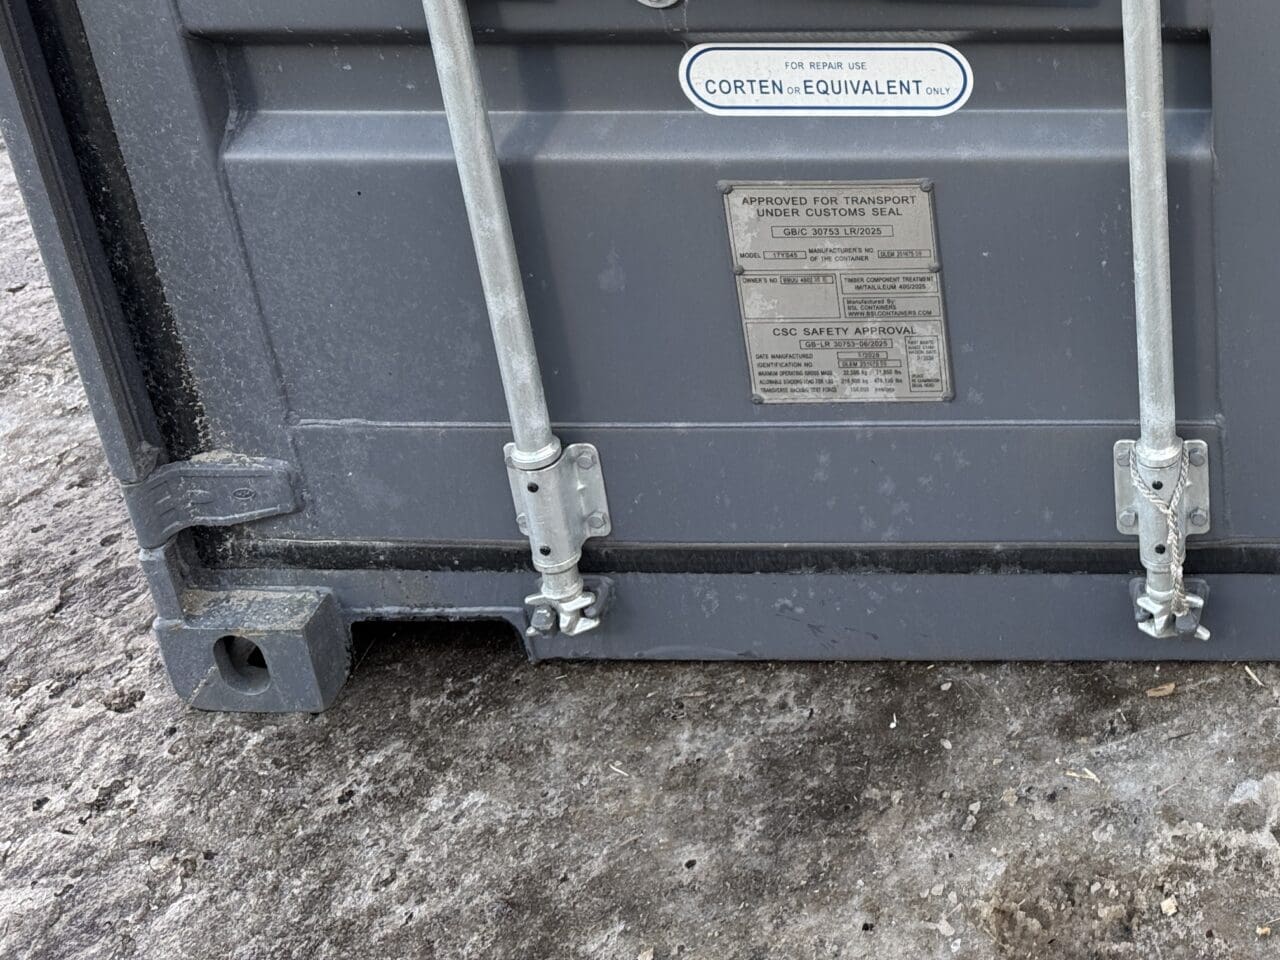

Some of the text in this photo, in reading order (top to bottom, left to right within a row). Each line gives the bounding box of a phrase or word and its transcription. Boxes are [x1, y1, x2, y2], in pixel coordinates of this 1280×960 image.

[785, 61, 867, 70] FOR REPAIR USE
[705, 79, 950, 95] CORTEN OR EQUIVALENT ONLY
[742, 196, 916, 206] APPROVED FOR TRANSPORT
[756, 208, 903, 217] UNDER CUSTOMS SEAL
[783, 228, 807, 236] GB/C
[812, 228, 839, 236] 30753
[773, 326, 916, 336] CSC SAFETY APPROVAL
